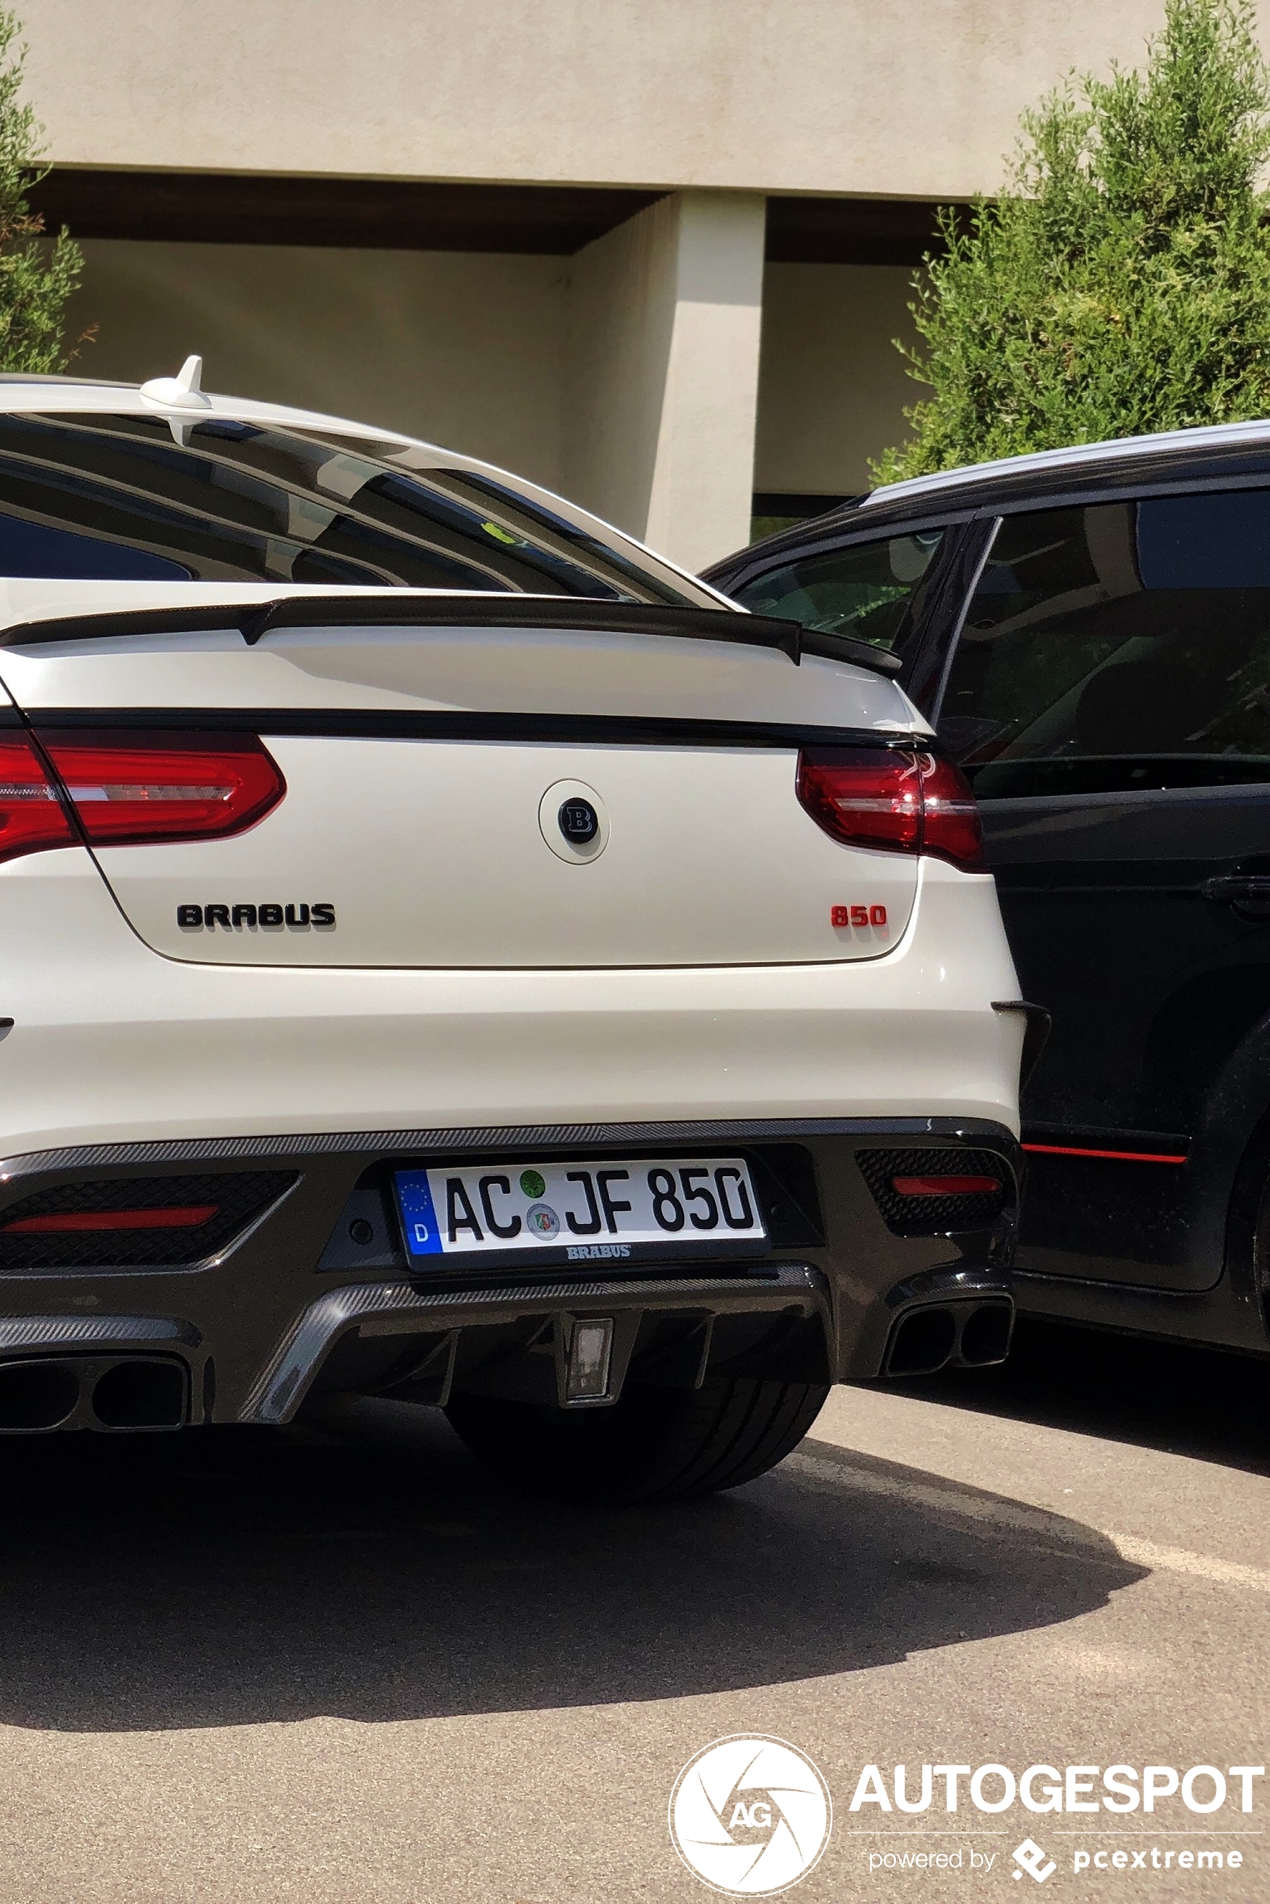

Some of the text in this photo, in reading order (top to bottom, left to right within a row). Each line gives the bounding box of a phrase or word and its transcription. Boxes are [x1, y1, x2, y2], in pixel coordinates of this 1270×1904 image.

[177, 902, 336, 929] BRABUS
[830, 904, 888, 928] 850
[445, 1174, 522, 1243] AC
[565, 1169, 632, 1236] JF
[647, 1166, 755, 1233] 850
[414, 1223, 429, 1243] D
[567, 1245, 631, 1260] BRABUS
